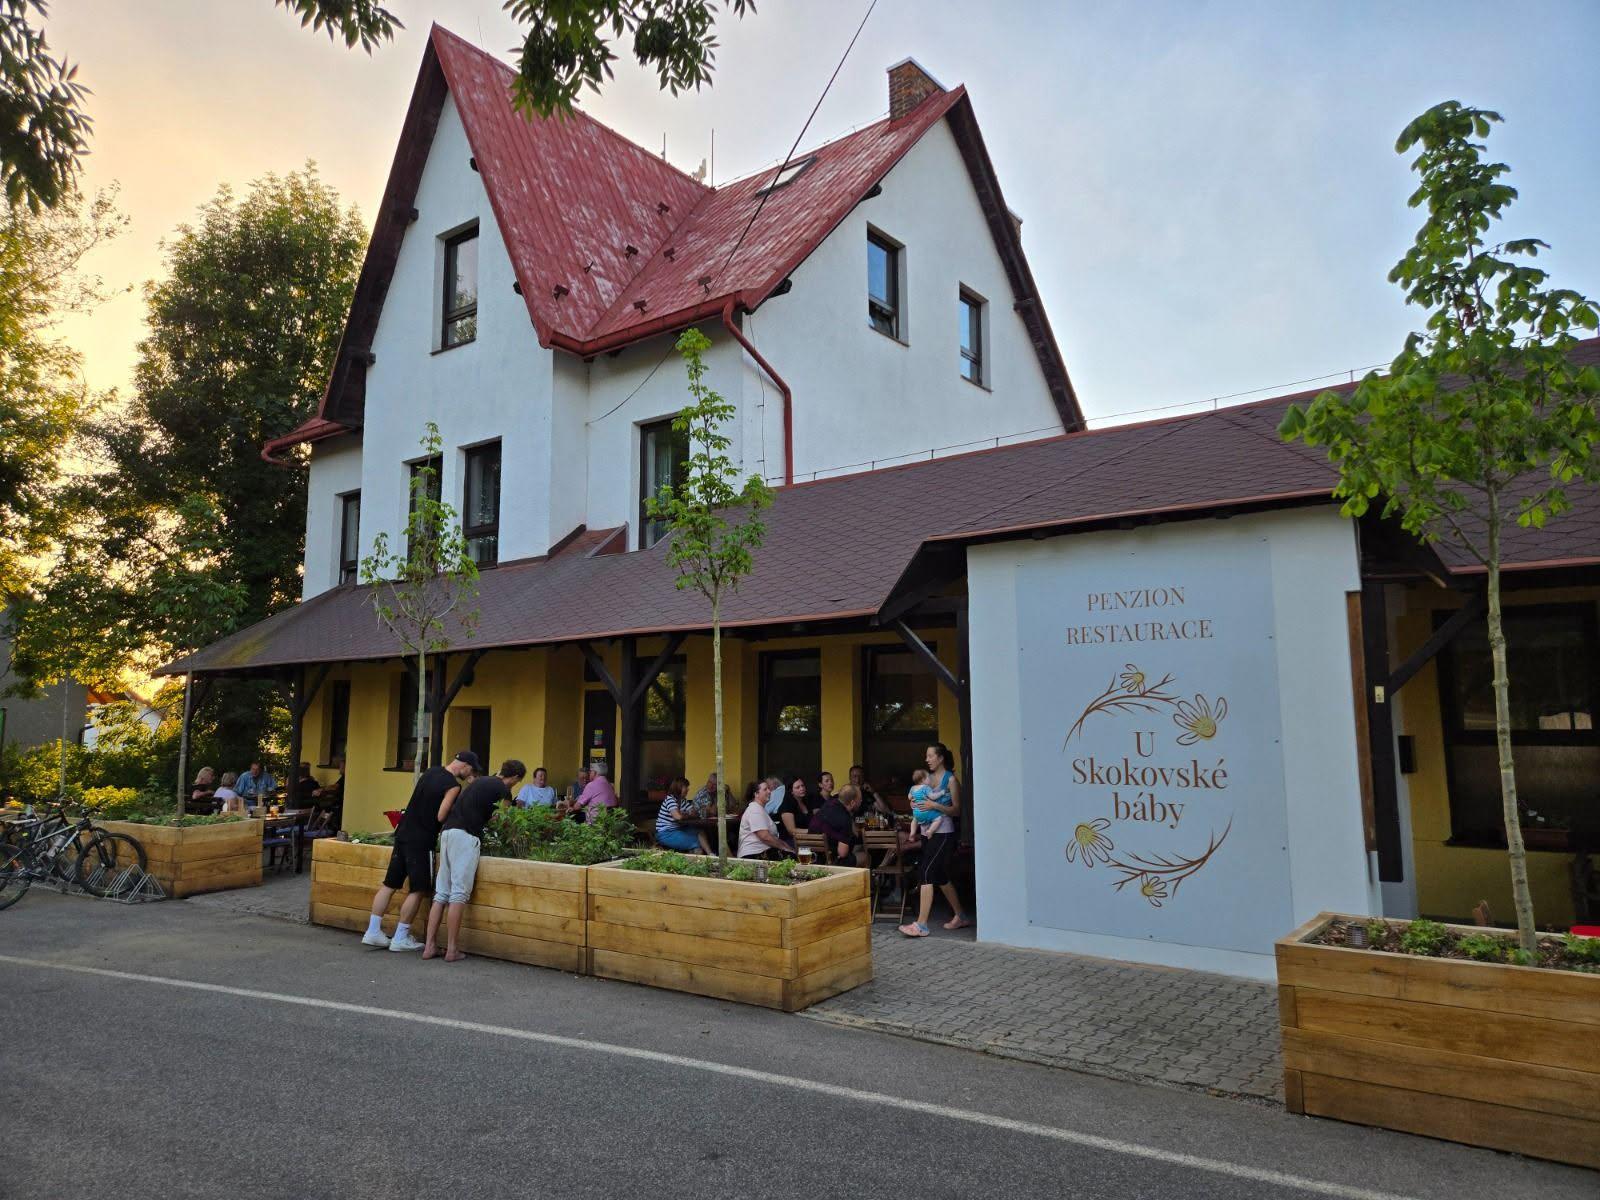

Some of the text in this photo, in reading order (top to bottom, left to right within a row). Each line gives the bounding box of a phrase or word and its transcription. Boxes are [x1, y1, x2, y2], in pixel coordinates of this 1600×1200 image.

[1087, 586, 1185, 611] PENZION
[1066, 619, 1213, 644] RESTAURACE
[1134, 731, 1155, 757] U
[1072, 757, 1228, 789] Skokovské
[1112, 792, 1185, 829] báby
